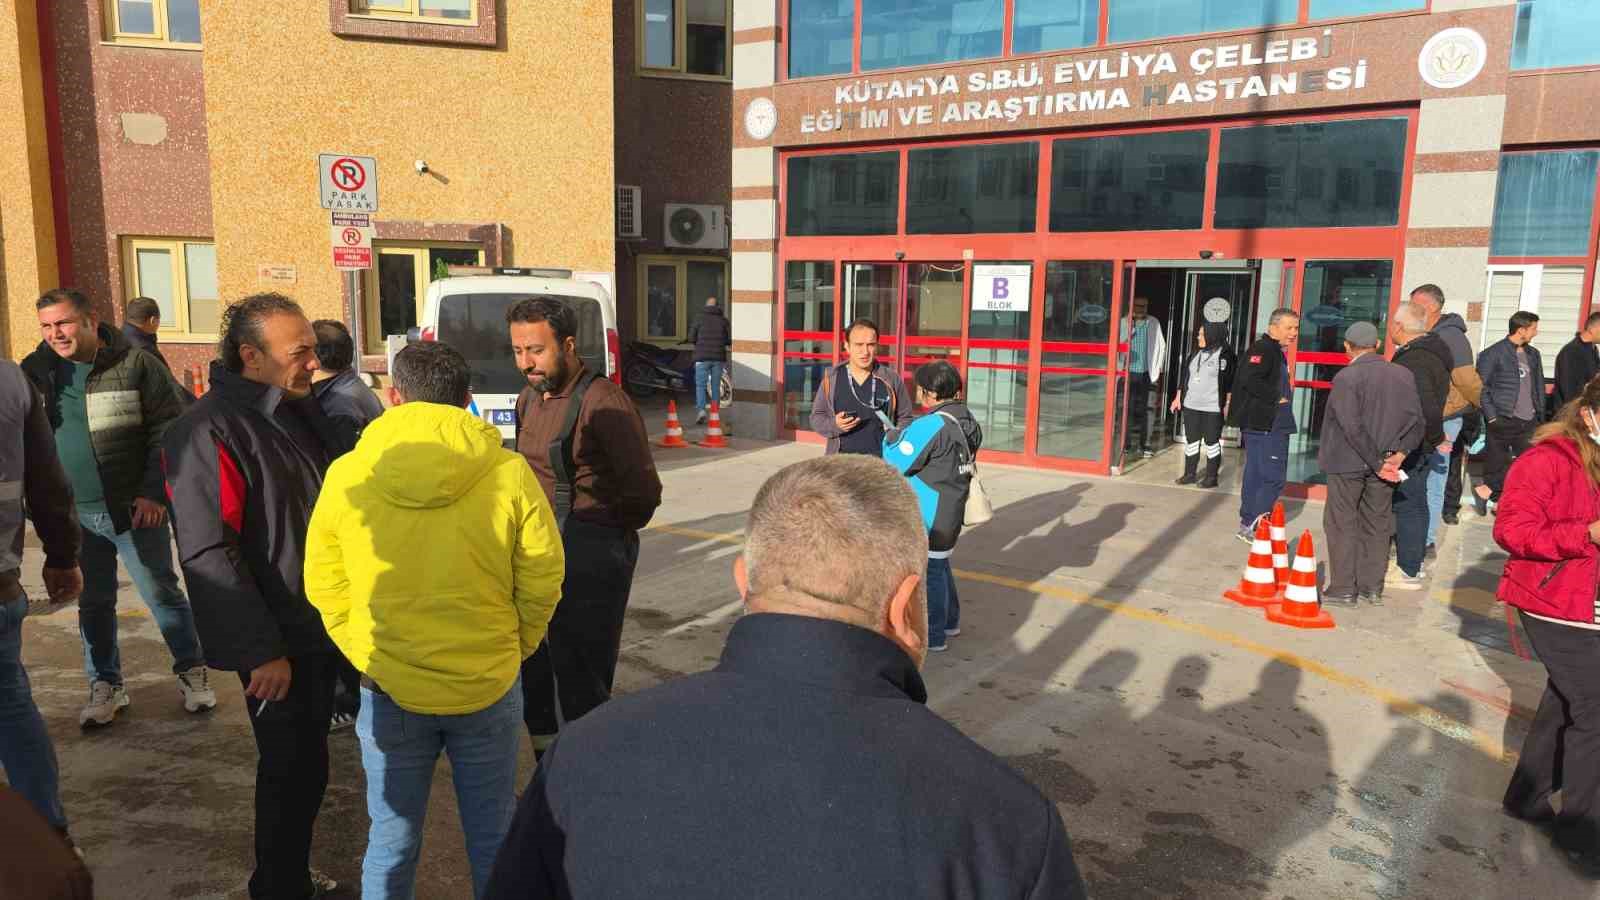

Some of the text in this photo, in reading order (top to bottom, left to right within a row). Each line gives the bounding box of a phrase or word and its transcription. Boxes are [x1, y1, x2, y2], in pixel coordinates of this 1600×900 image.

[835, 74, 959, 105] KÜTAHYA
[1053, 51, 1177, 84] EVLİYA
[1189, 29, 1333, 75] ÇELEBİ
[897, 105, 934, 126] VE
[941, 87, 1130, 122] ARAŞTIRMA
[1143, 60, 1369, 107] HASTANESİ
[331, 191, 368, 201] PARK
[328, 200, 373, 209] YASAK
[992, 277, 1009, 299] B
[987, 301, 1012, 309] BLOK
[497, 411, 512, 422] 43
